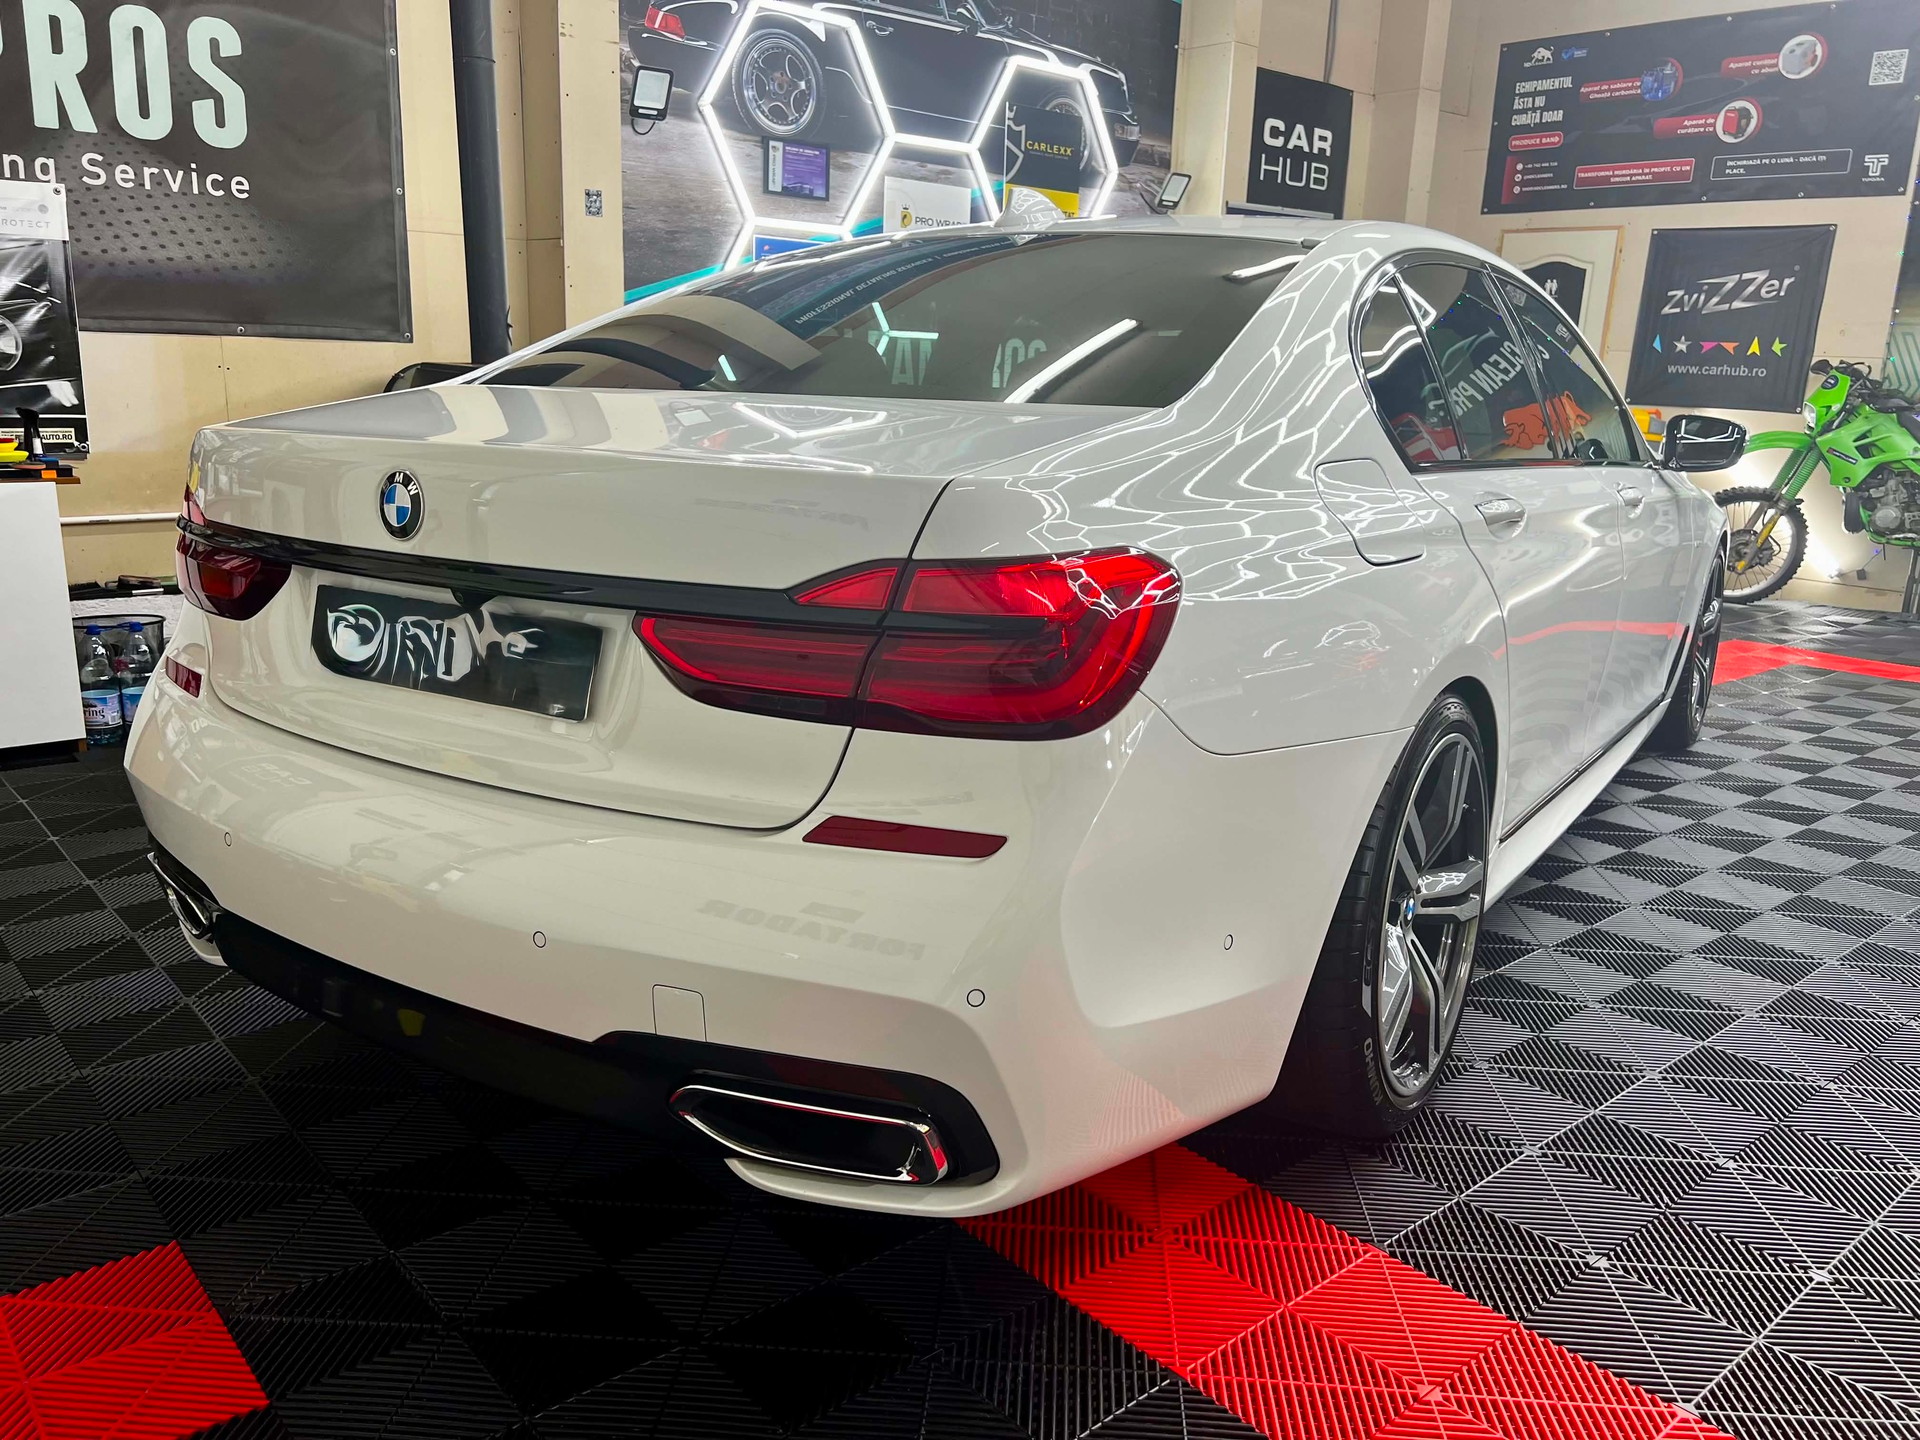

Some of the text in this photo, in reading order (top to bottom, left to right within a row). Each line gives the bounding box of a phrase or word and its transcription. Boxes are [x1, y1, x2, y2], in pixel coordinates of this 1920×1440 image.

[0, 0, 248, 149] ROS
[1515, 76, 1573, 94] ECHIPAMENTUL
[1513, 95, 1546, 110] ĂSTA NU
[1542, 109, 1564, 123] DOAR
[1263, 117, 1333, 157] CAR
[1511, 137, 1541, 147] PRODUCE
[1026, 140, 1073, 156] CARLEXX
[81, 152, 251, 199] Service
[1260, 153, 1329, 191] HUB
[914, 216, 934, 227] PRO
[1667, 364, 1767, 377] www.carhub.ro
